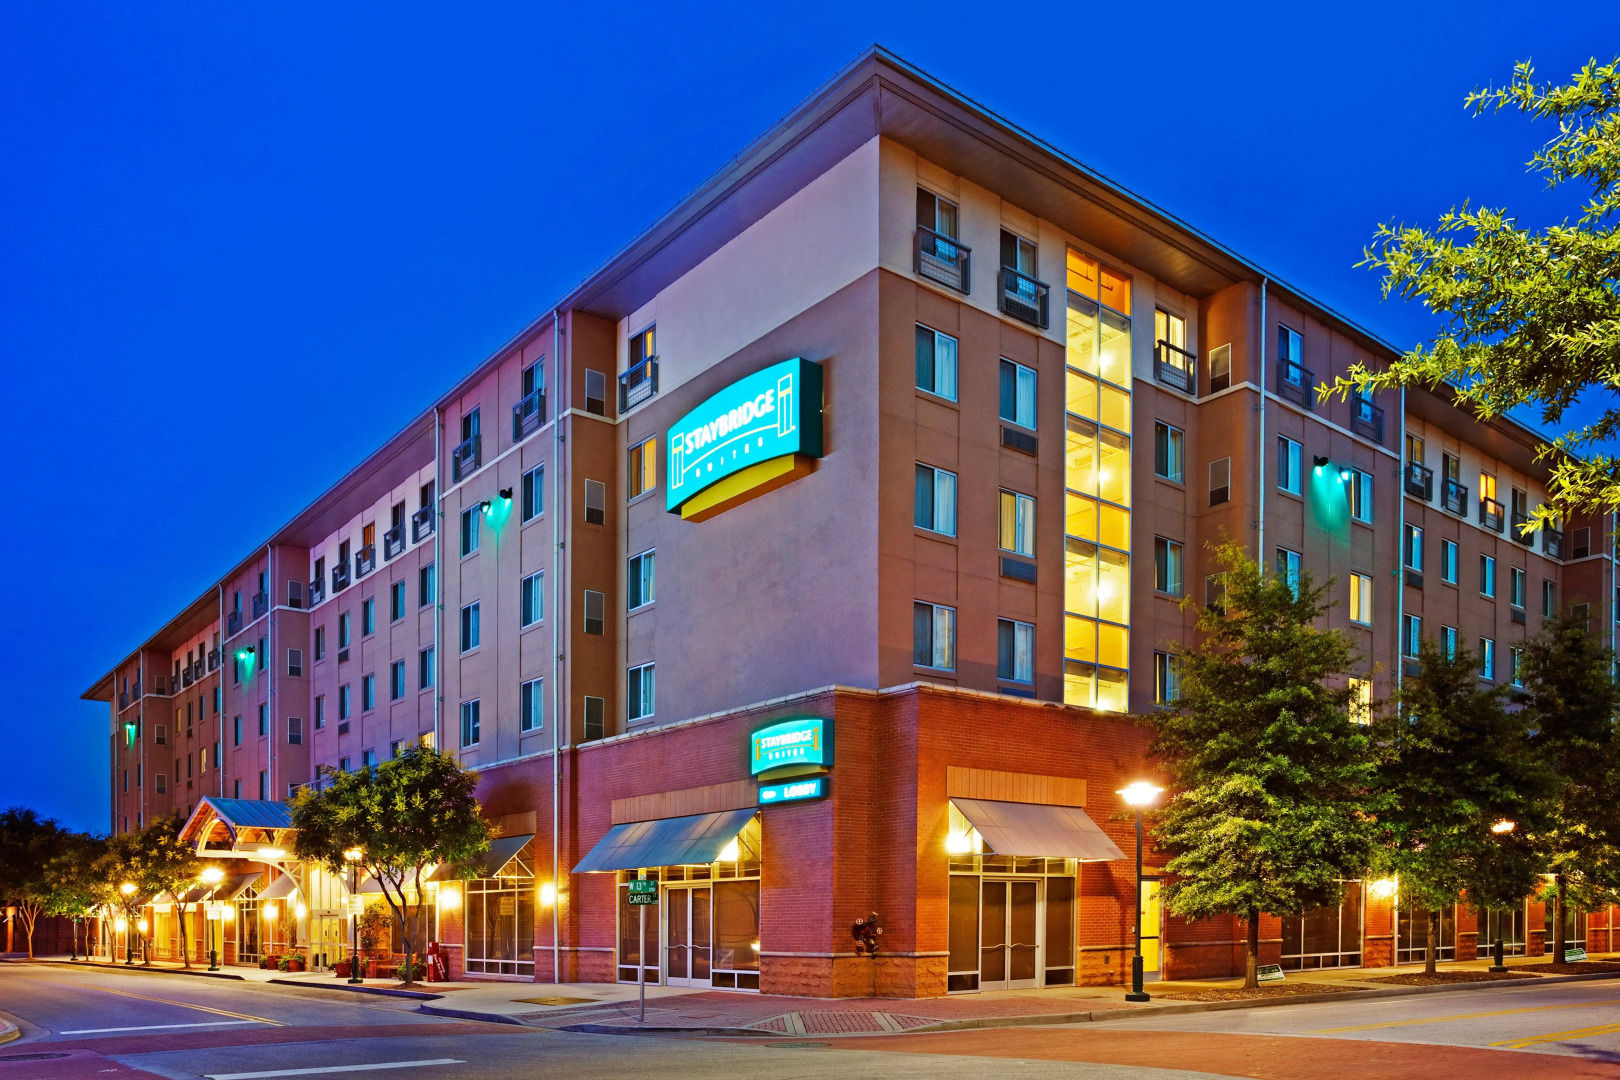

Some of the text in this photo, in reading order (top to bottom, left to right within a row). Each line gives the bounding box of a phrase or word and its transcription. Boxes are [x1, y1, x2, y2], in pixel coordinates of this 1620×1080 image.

[685, 388, 775, 455] STAYBRIDGE
[695, 437, 763, 478] SUITES
[761, 730, 812, 749] STAYBRIDGE
[768, 747, 804, 760] SUITES
[784, 782, 816, 798] LOBBY
[629, 882, 634, 890] W
[629, 895, 651, 904] CARTER
